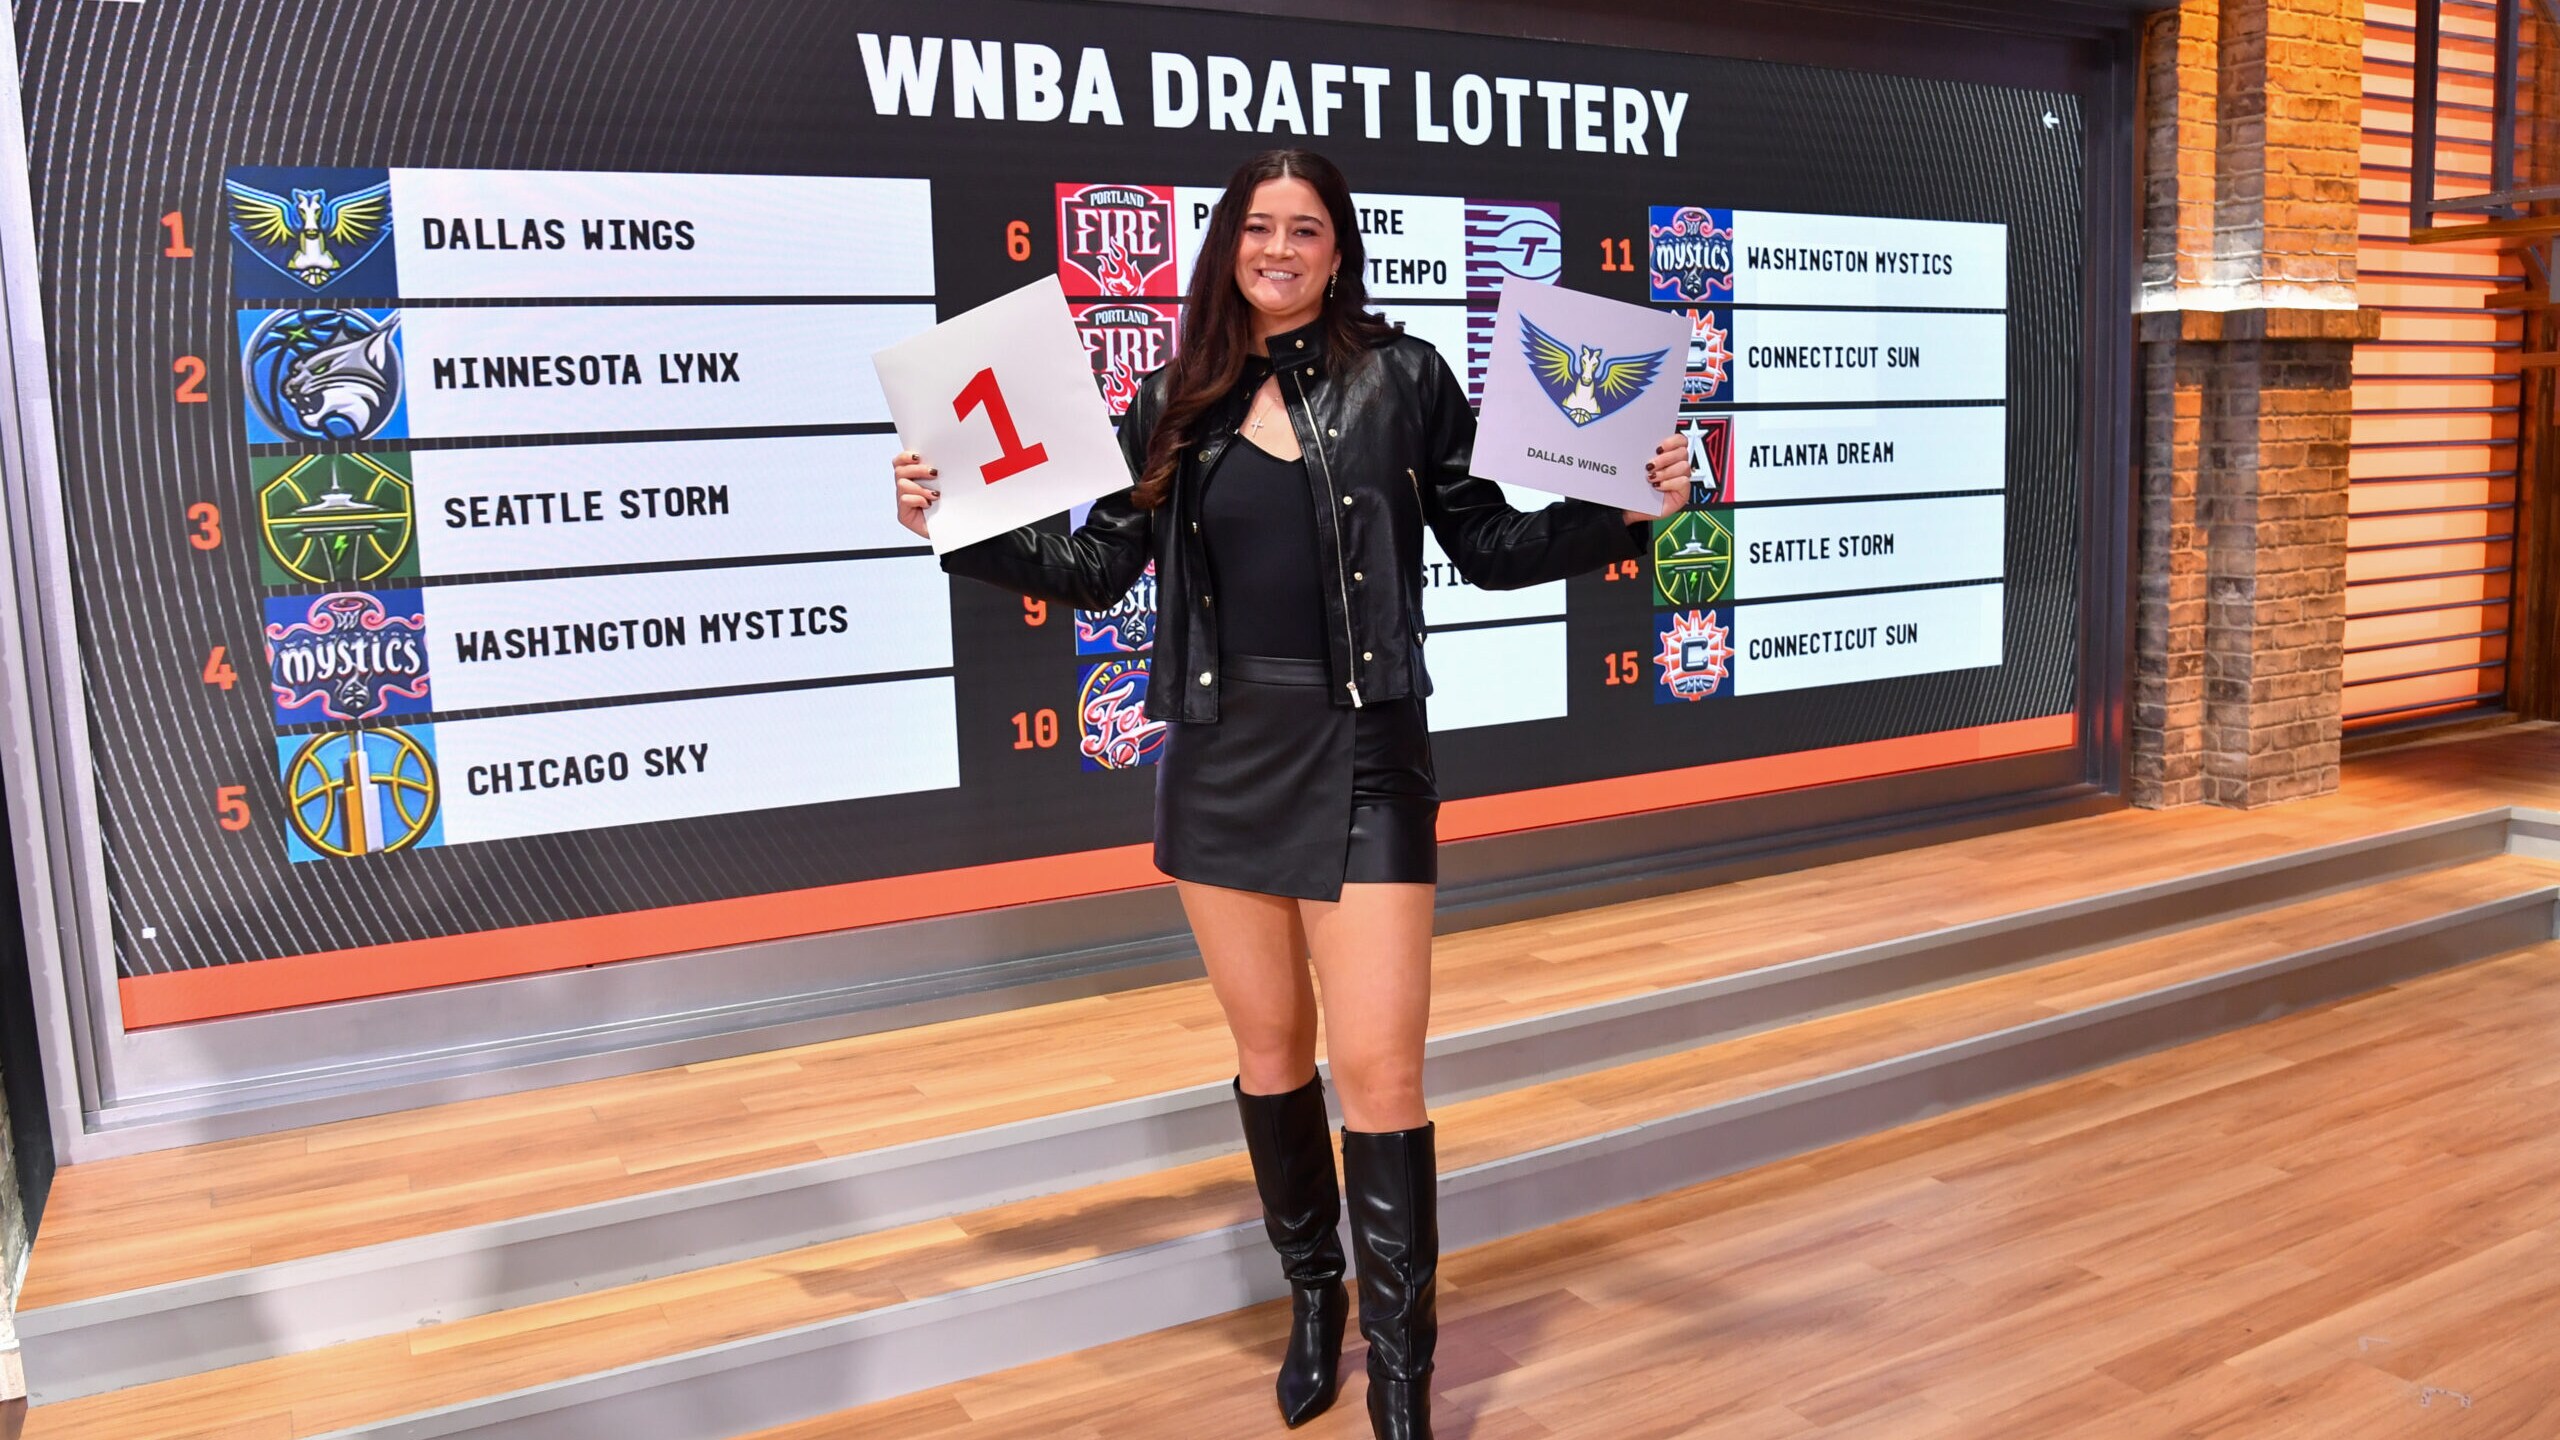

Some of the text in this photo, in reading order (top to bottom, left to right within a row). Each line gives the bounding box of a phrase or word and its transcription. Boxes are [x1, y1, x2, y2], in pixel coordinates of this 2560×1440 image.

[857, 34, 1689, 157] WNBA DRAFT LOTTERY
[1090, 190, 1145, 208] PORTLAND
[161, 212, 194, 259] 1
[423, 218, 695, 251] DALLAS WINGS
[1072, 208, 1162, 255] FIRE
[1360, 208, 1404, 235] IRE
[1007, 221, 1031, 262] 6
[1601, 238, 1635, 272] 11
[1368, 258, 1447, 285] TEMPO
[1748, 247, 1952, 275] WASHINGTON MYSTICS
[1095, 308, 1149, 327] PORTLAND
[1080, 327, 1166, 373] FIRE
[1749, 347, 1920, 369] CONNECTICUT SUN
[173, 356, 209, 404] 2
[434, 353, 740, 390] MINNESOTA LYNX
[952, 366, 1049, 485] 1
[1527, 447, 1618, 476] DALLAS WINGS
[1750, 442, 1894, 468] ATLANTA DREAM
[445, 485, 729, 529] SEATTLE STORM
[188, 502, 222, 551] 3
[1750, 534, 1894, 564] SEATTLE STORM
[1023, 595, 1047, 626] 9
[456, 617, 686, 663] WASHINGTON
[701, 606, 848, 644] MYSTICS
[1750, 624, 1918, 661] CONNECTICUT SUN
[203, 646, 238, 691] 4
[1092, 659, 1147, 695] INDIA
[1604, 650, 1639, 686] 15
[1012, 709, 1059, 750] 10
[468, 744, 708, 796] CHICAGO SKY
[217, 786, 251, 832] 5
